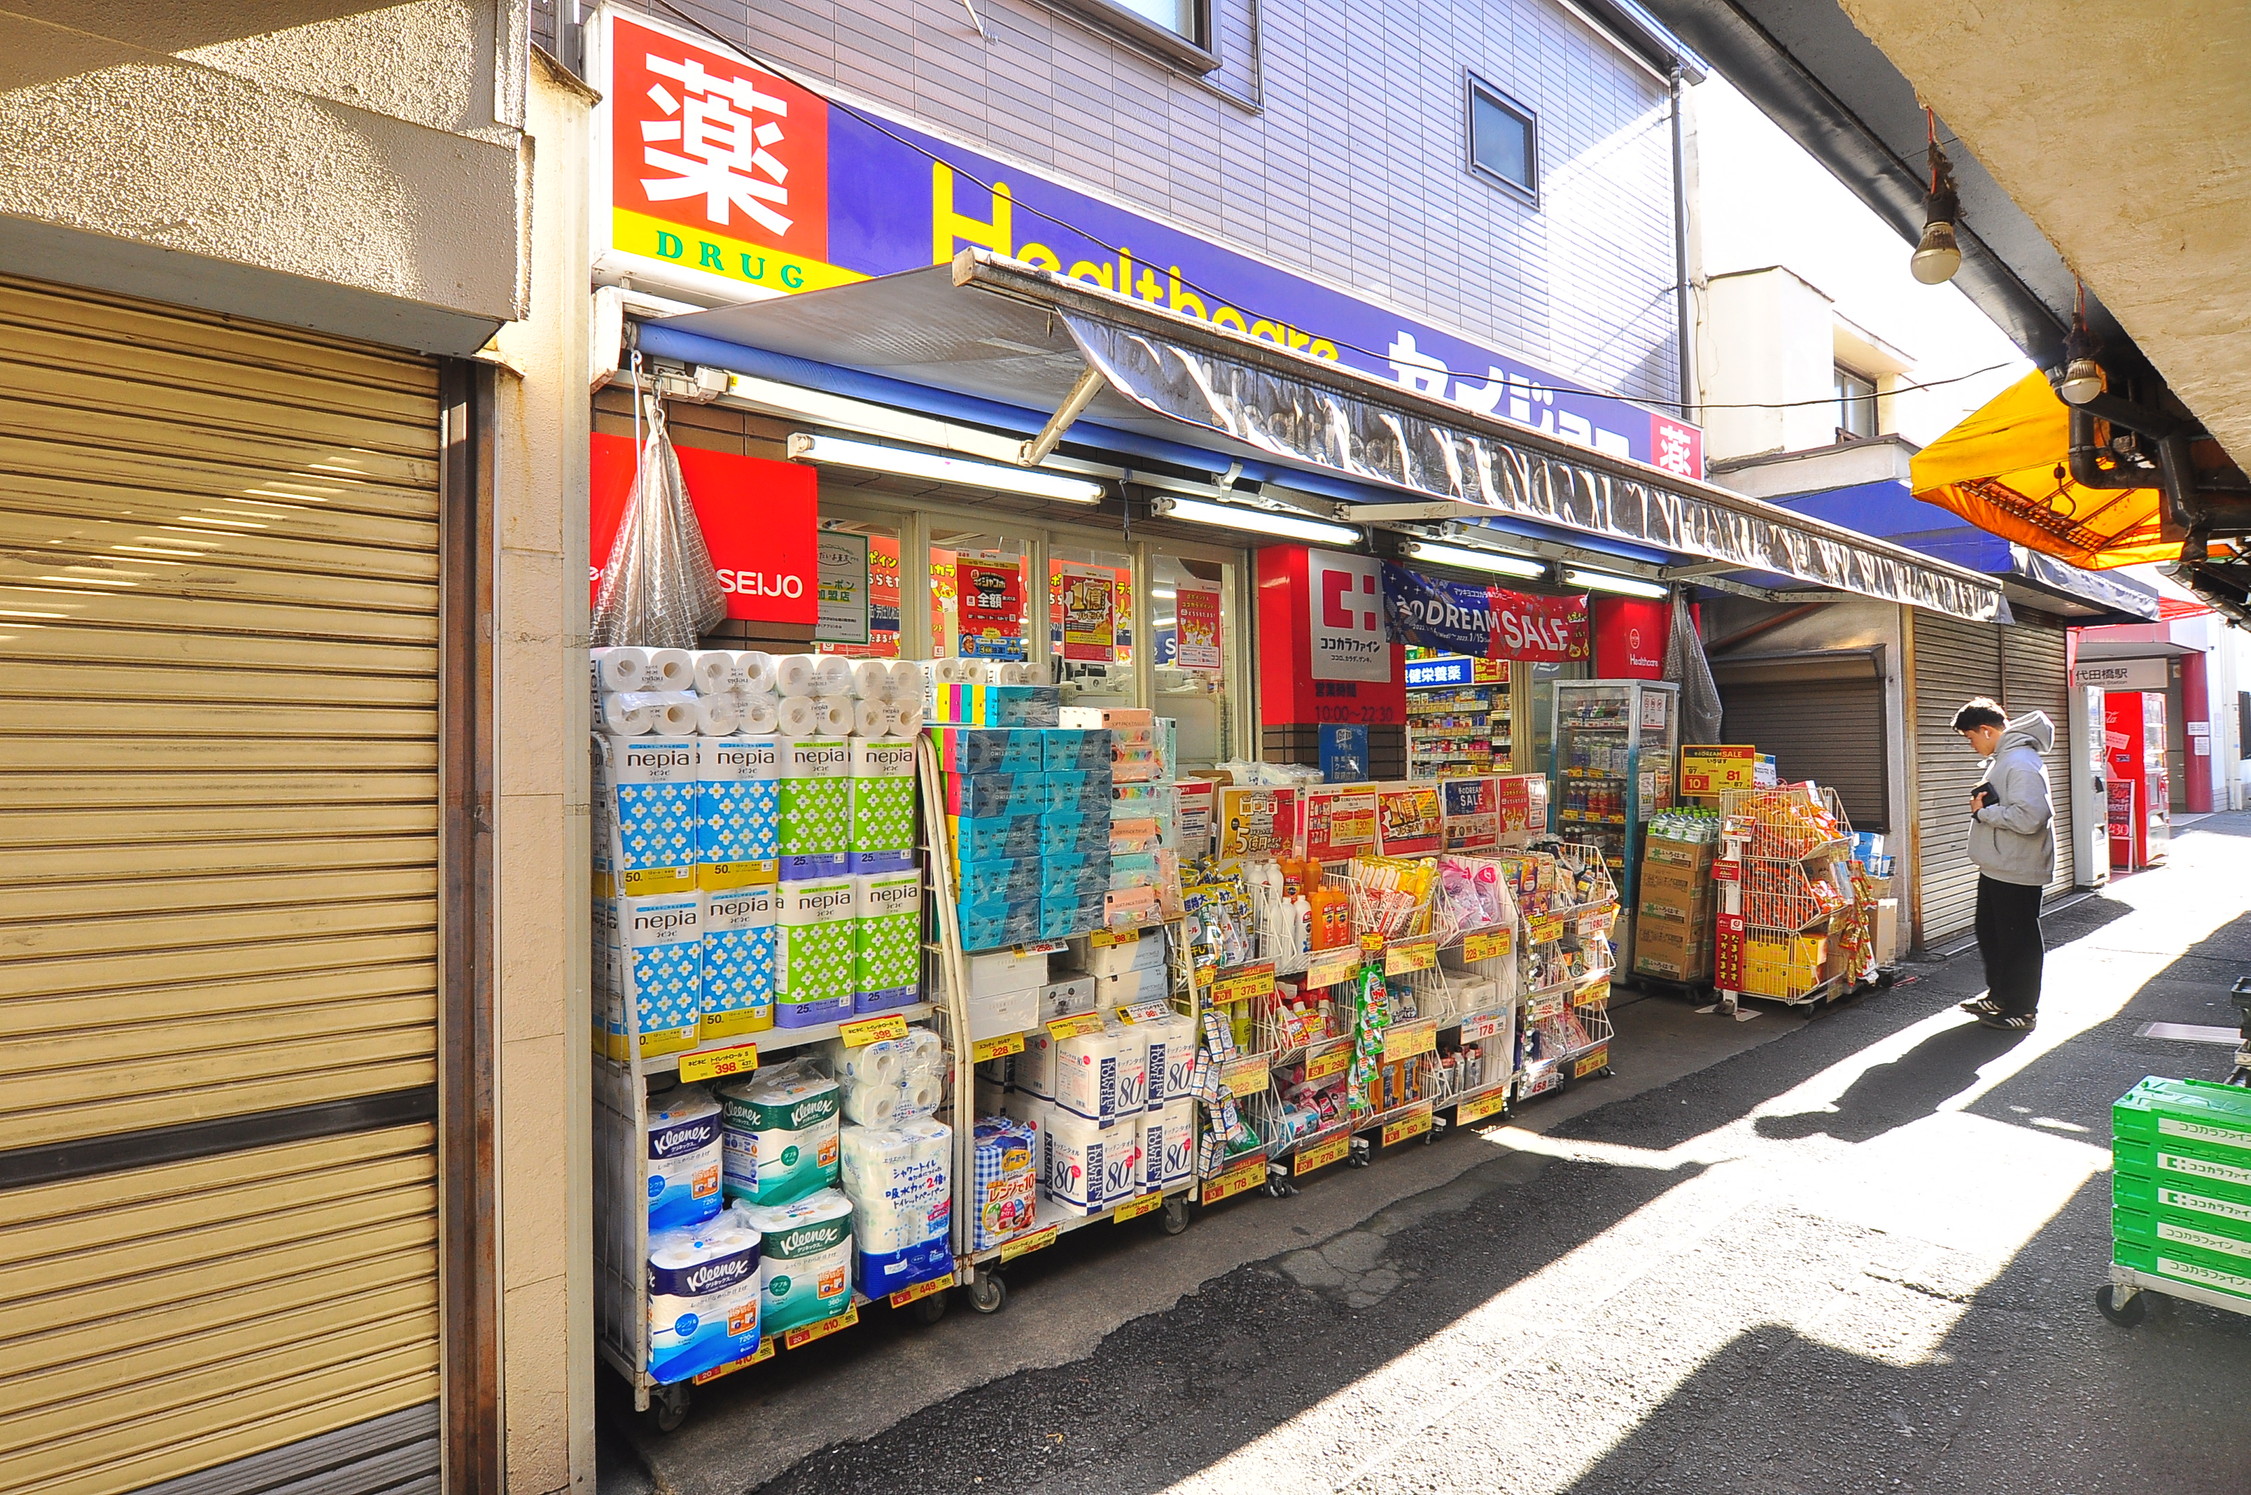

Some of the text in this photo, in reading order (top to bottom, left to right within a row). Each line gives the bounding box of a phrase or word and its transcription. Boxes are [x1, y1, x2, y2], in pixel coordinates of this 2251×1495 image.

[640, 52, 794, 237] 薬
[656, 229, 805, 289] DRUG
[1658, 426, 1692, 476] 薬
[717, 568, 803, 599] SEIJO
[977, 594, 1003, 609] 全額
[1501, 610, 1569, 652] SALE
[1320, 637, 1381, 653] ココカラファイン
[1405, 664, 1462, 684] 健栄養薬
[2076, 668, 2128, 681] 代田橋駅
[627, 750, 690, 768] nepia
[717, 749, 775, 766] nepia
[794, 748, 845, 764] nepia
[866, 748, 913, 764] nepia
[1721, 750, 1743, 758] SALE
[1689, 778, 1701, 789] 10
[1726, 770, 1741, 781] 81
[1460, 795, 1483, 807] SALE
[1660, 849, 1687, 859] いろはす
[799, 891, 851, 910] nepia
[870, 885, 918, 903] nepia
[709, 897, 768, 916] nepia
[1653, 905, 1680, 915] いろはす
[634, 910, 697, 930] nepia
[1114, 934, 1126, 943] 198
[1465, 949, 1478, 960] 228
[1648, 960, 1675, 970] いろはす
[1216, 992, 1226, 1000] 70
[1240, 985, 1257, 996] 378
[872, 1030, 891, 1040] 398
[1479, 1024, 1494, 1037] 178
[710, 1051, 743, 1064] トイレットロール
[992, 1045, 1009, 1057] 228
[714, 1063, 737, 1075] 398
[1150, 1048, 1158, 1090] TOWELS
[1156, 1047, 1165, 1098] KITCHEN
[1331, 1059, 1346, 1071] 298
[1166, 1062, 1191, 1093] 80
[1118, 1076, 1141, 1108] 80
[1532, 1081, 1548, 1093] 458
[724, 1100, 761, 1126] Kleenex
[790, 1099, 833, 1127] Kleenex
[1406, 1124, 1418, 1134] 180
[654, 1126, 711, 1155] Kleenex
[1147, 1131, 1156, 1172] TOWELS
[1154, 1130, 1162, 1180] KITCHEN
[1164, 1142, 1188, 1174] 80
[1320, 1151, 1334, 1163] 278
[893, 1159, 937, 1180] シャワートイレ
[1054, 1160, 1075, 1194] 80
[1088, 1148, 1096, 1192] TOWELS
[1094, 1148, 1103, 1200] KITCHEN
[1106, 1159, 1130, 1192] 80
[1233, 1178, 1248, 1190] 178
[893, 1186, 946, 1209] トイレットペーパー
[1135, 1204, 1149, 1215] 228
[780, 1227, 837, 1256] Kleenex
[2165, 1228, 2233, 1250] ココカラファイン
[686, 1259, 748, 1292] Kleenex
[2169, 1261, 2246, 1286] ココカラファイン
[920, 1282, 937, 1294] 449
[676, 1319, 698, 1329] シングル
[823, 1319, 840, 1332] 410
[792, 1335, 803, 1344] 20
[701, 1369, 712, 1379] 20
